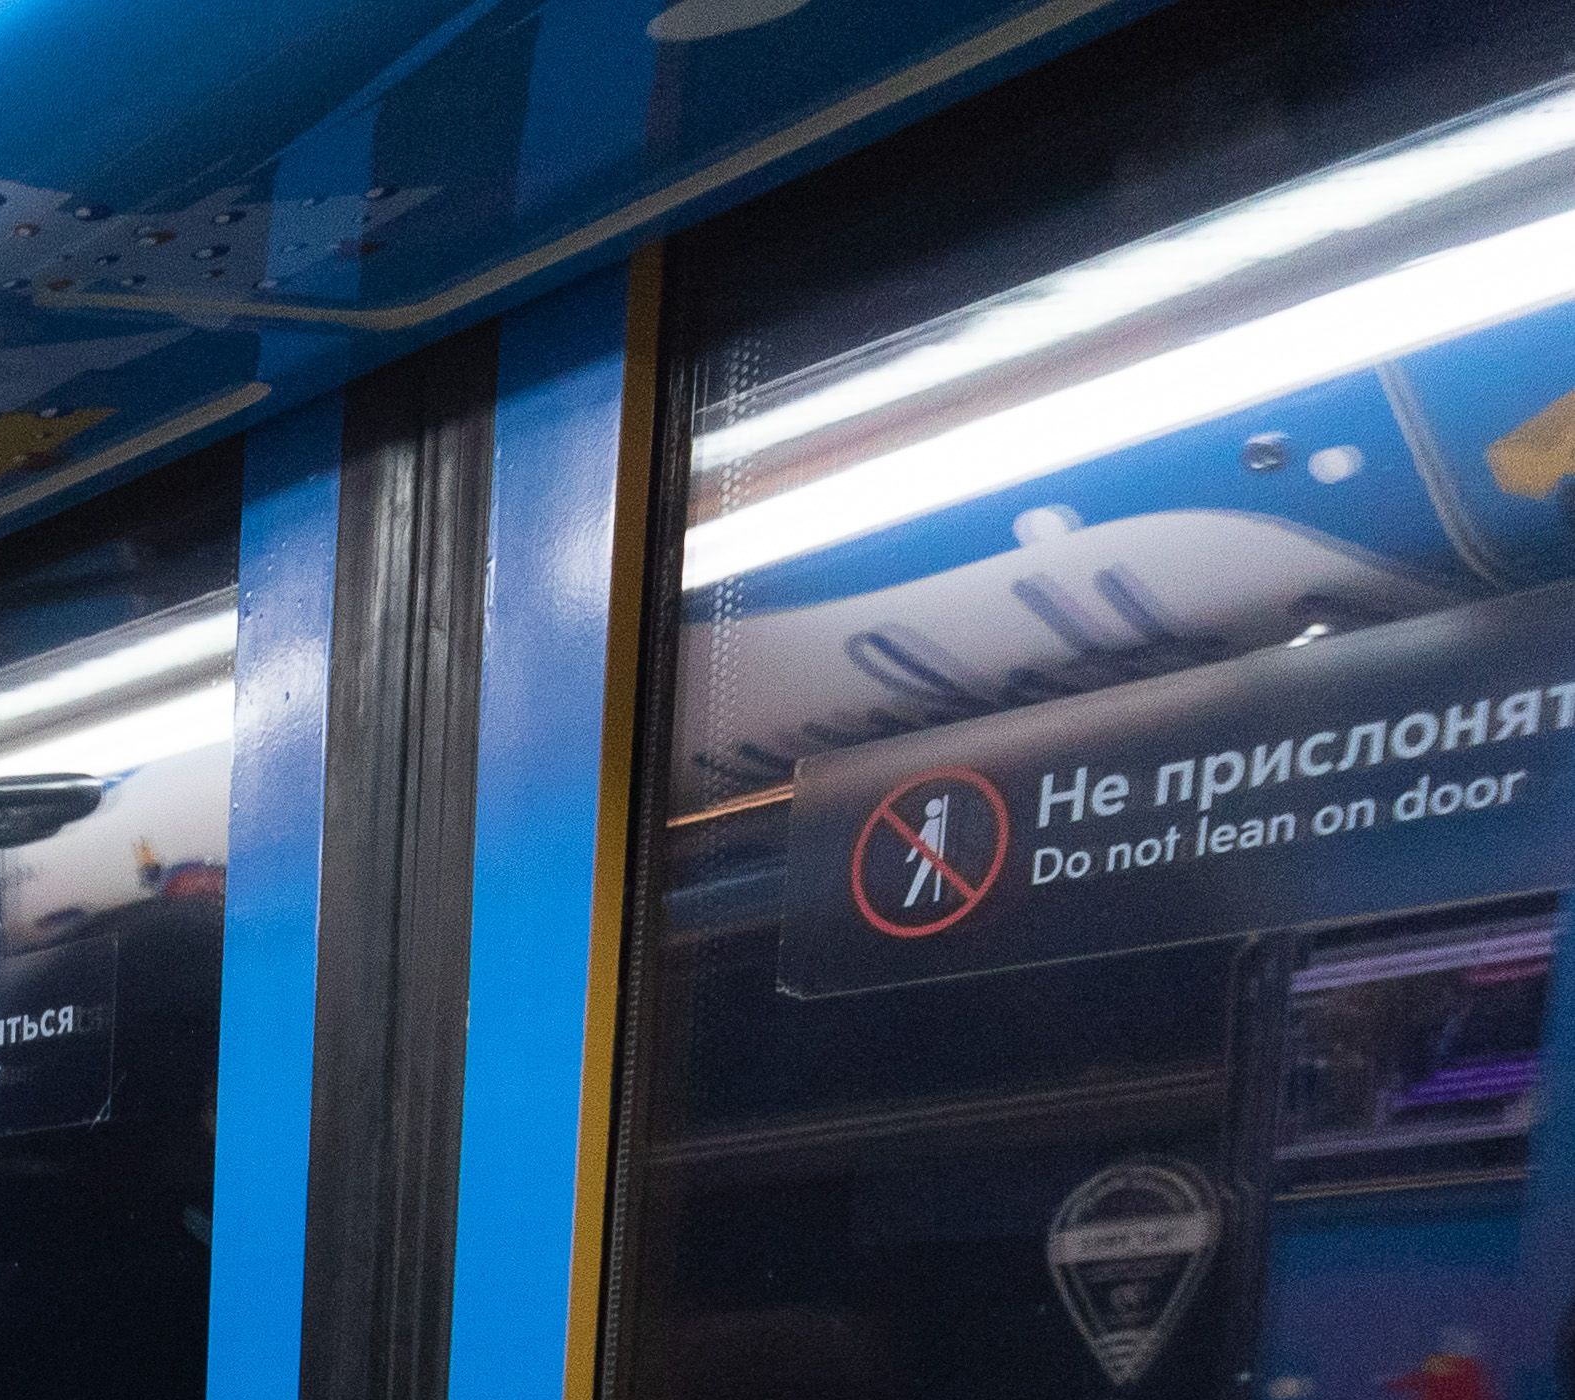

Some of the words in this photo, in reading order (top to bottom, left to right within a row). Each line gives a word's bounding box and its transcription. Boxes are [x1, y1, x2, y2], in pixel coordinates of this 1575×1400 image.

[1031, 846, 1092, 885] Do
[1106, 827, 1182, 874] not
[1197, 808, 1296, 857] lean
[1312, 799, 1376, 836] on
[1392, 769, 1527, 822] door
[1036, 766, 1131, 828] Не
